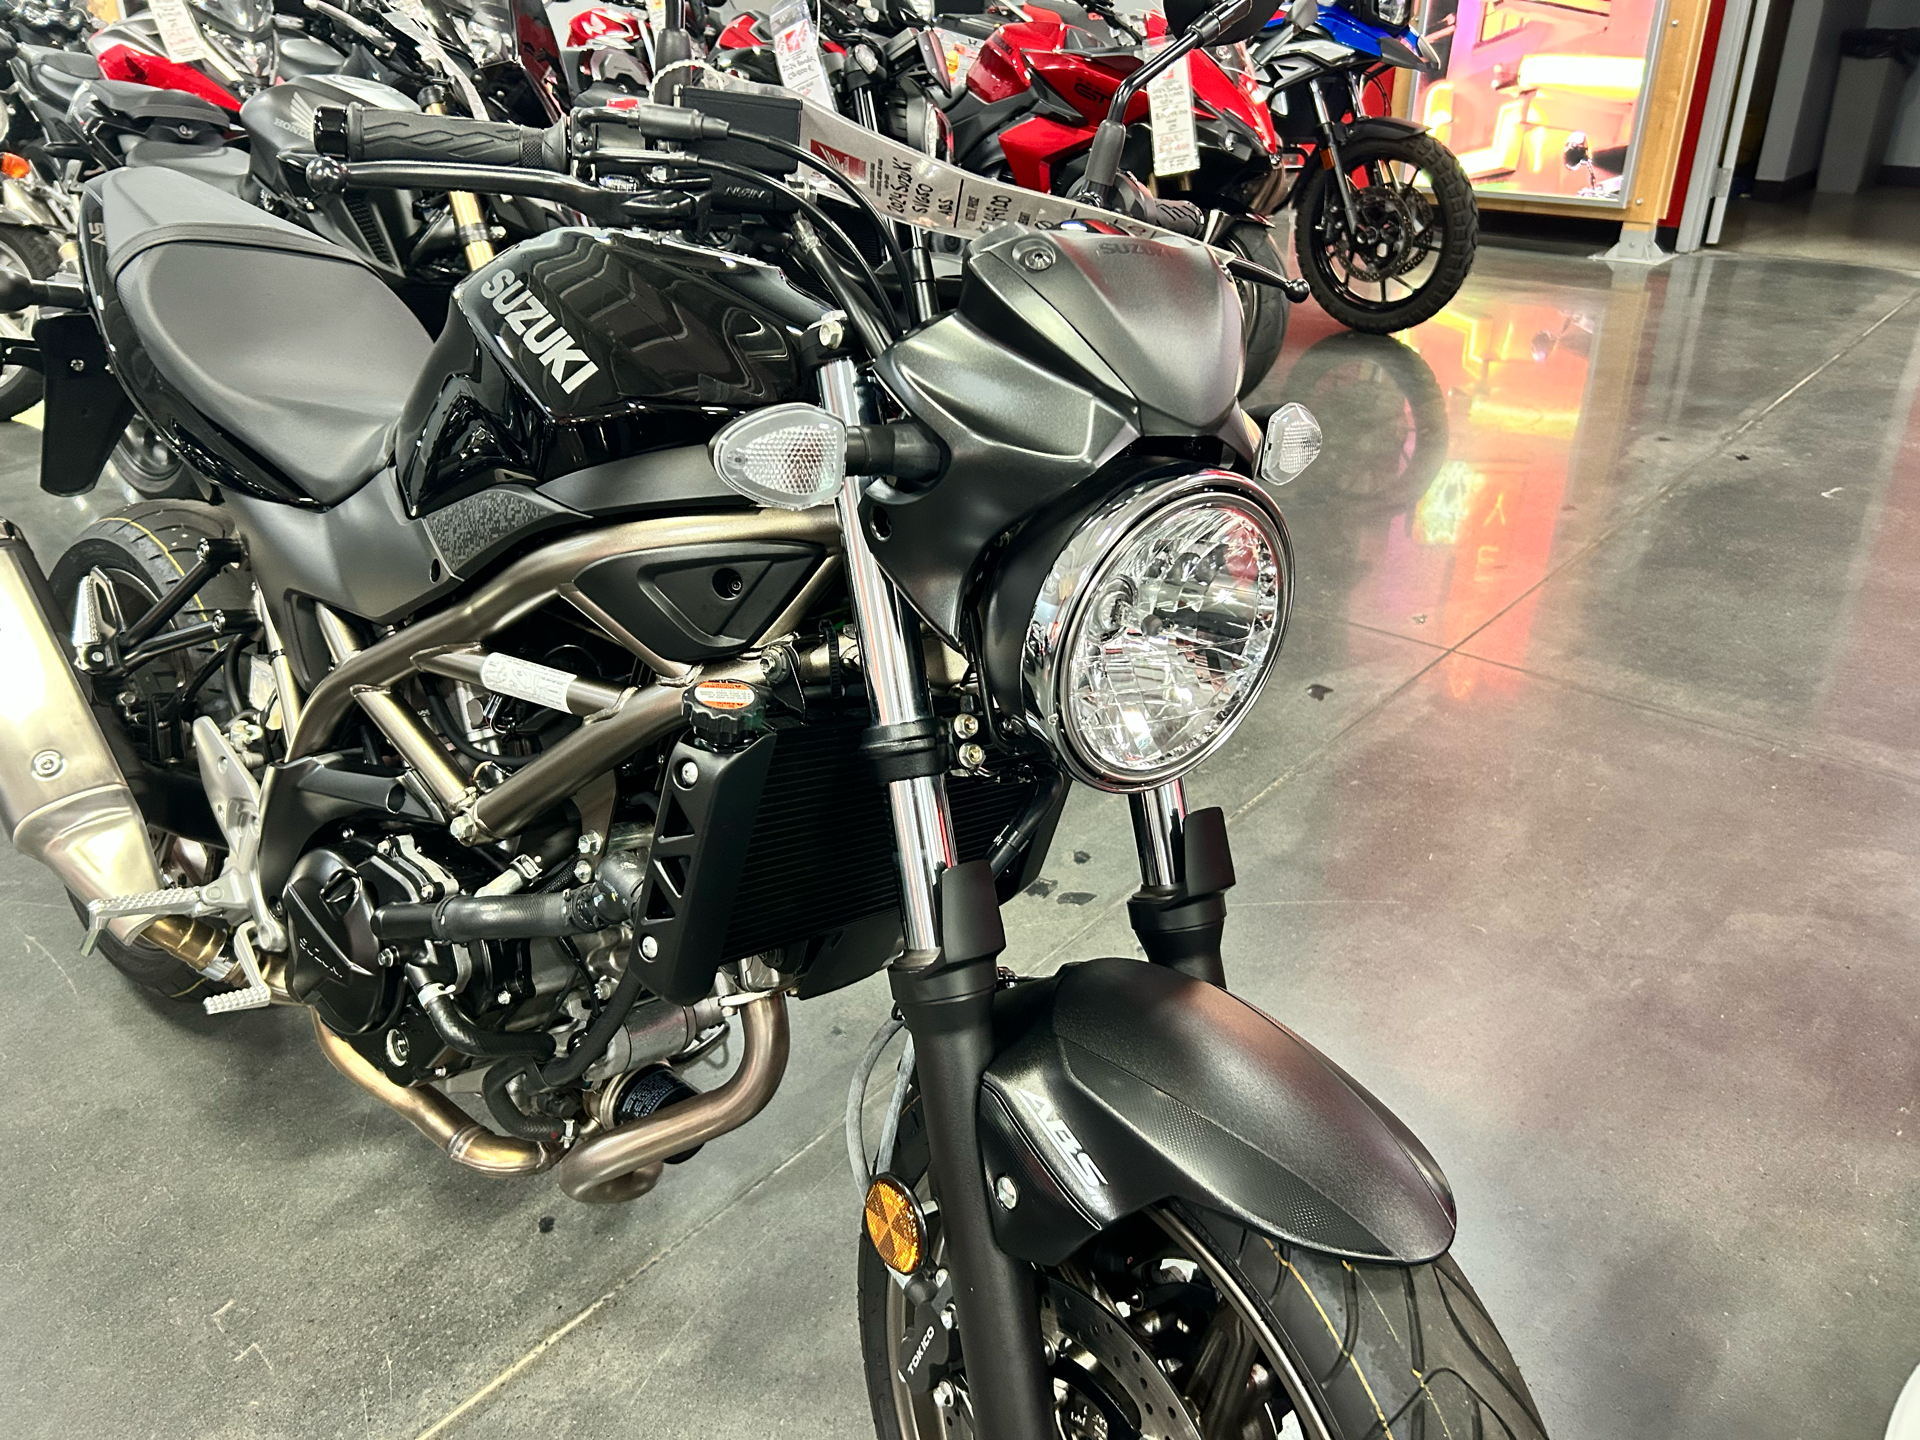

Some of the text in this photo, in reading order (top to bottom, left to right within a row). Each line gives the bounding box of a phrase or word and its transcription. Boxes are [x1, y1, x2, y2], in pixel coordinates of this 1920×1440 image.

[887, 192, 908, 214] 2024
[912, 183, 933, 214] SV650
[938, 198, 954, 217] ABS
[481, 268, 599, 395] SUZUKI
[1015, 1088, 1109, 1192] ABS
[907, 1326, 934, 1375] TOKICO
